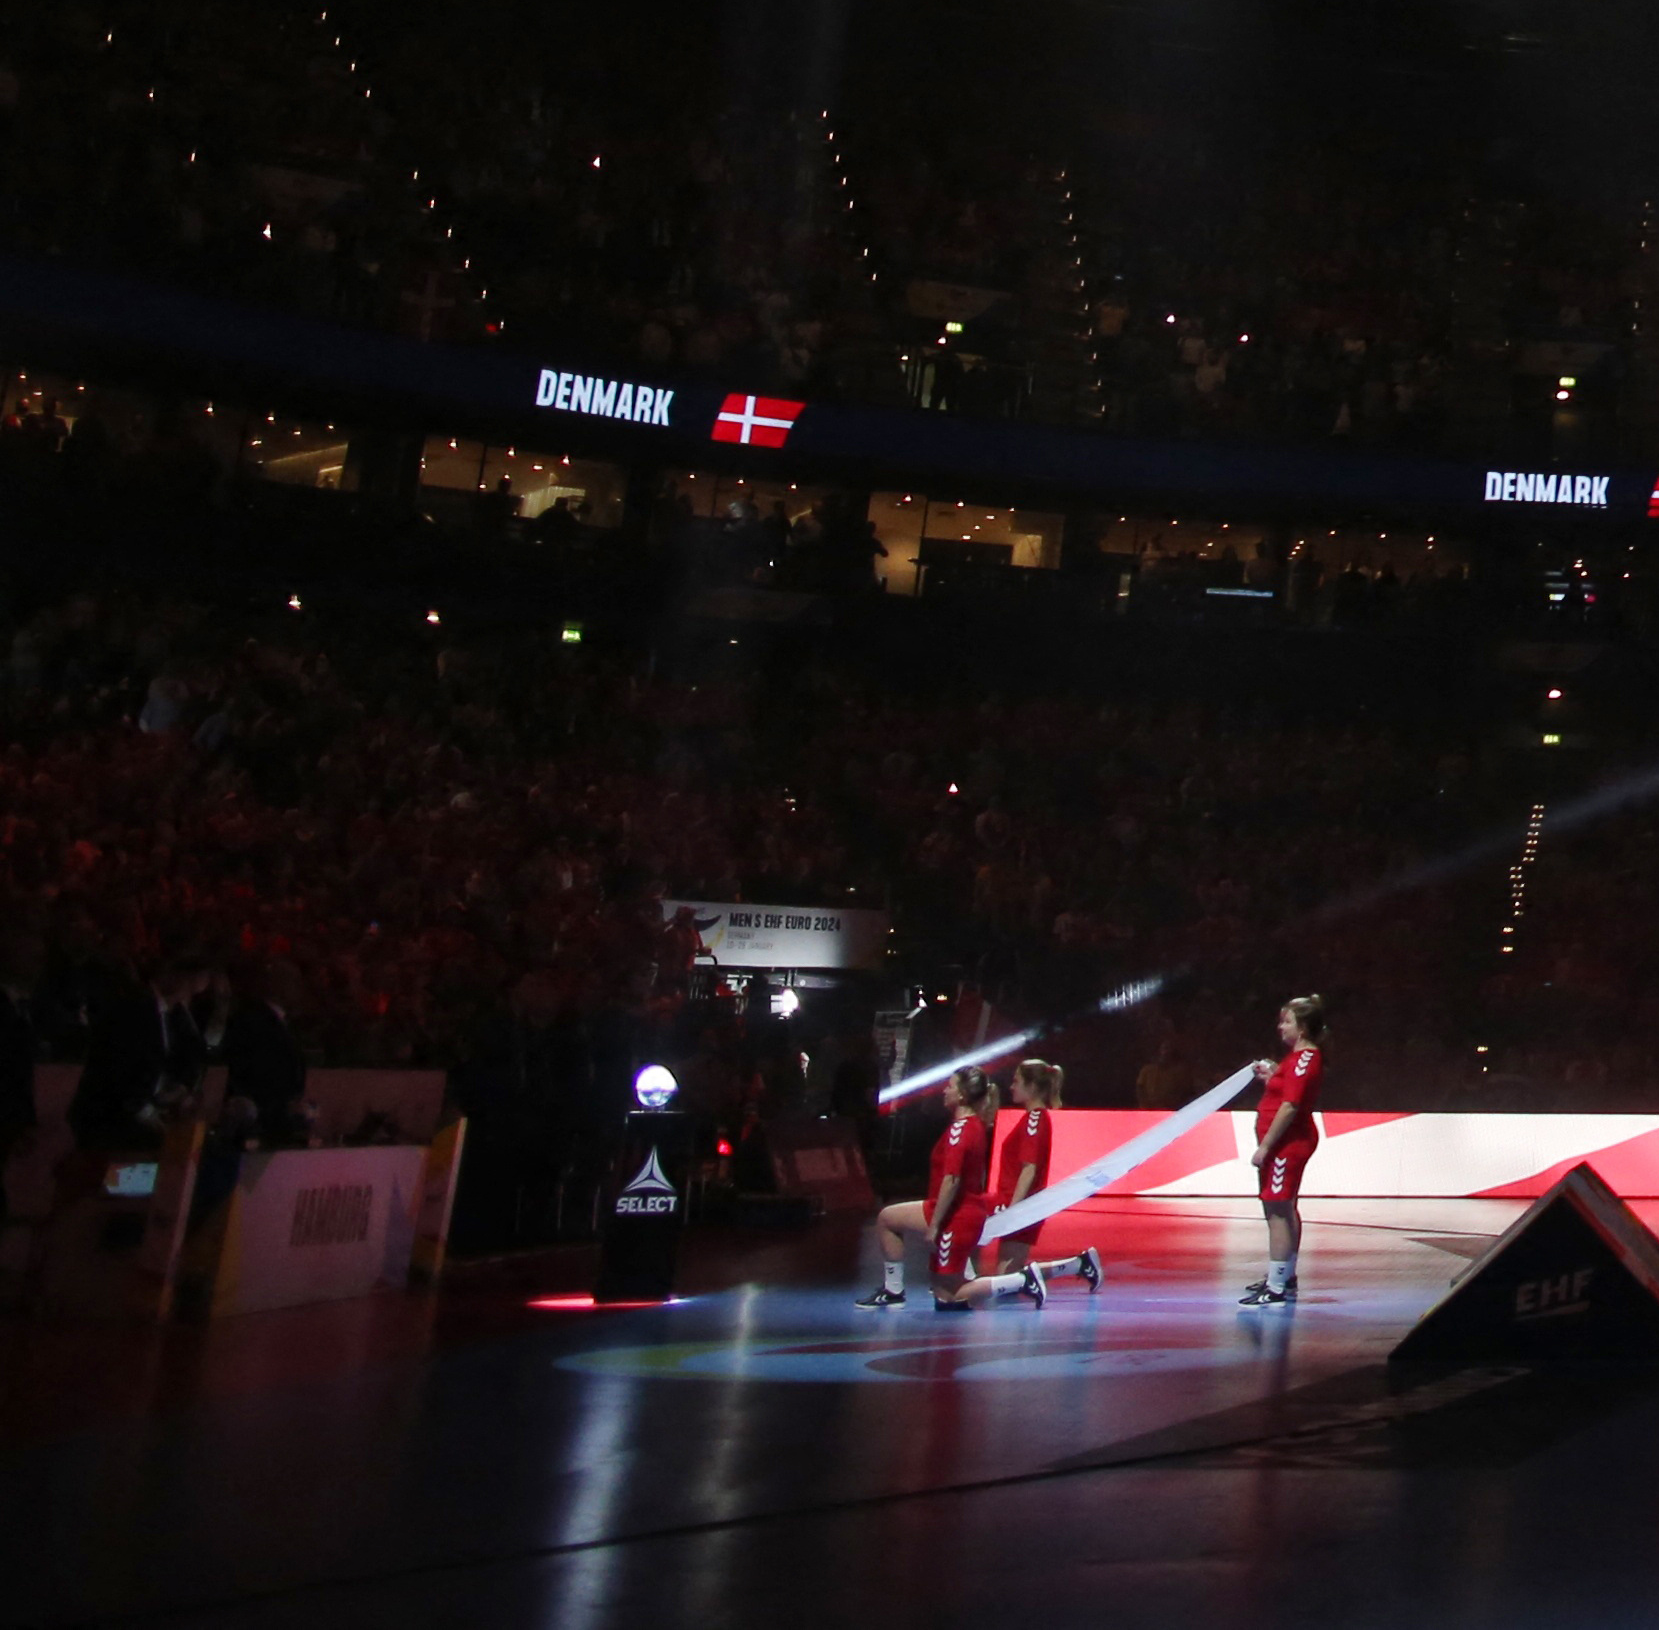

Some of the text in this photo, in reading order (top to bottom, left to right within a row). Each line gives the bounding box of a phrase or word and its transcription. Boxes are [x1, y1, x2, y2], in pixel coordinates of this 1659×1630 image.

[536, 370, 673, 426] DENMARK
[1485, 471, 1609, 506] DENMARK
[764, 915, 783, 929] EHF
[785, 916, 812, 930] EURO
[814, 917, 841, 931] 2024
[616, 1197, 678, 1214] SELECT
[1516, 1268, 1595, 1314] EHF
